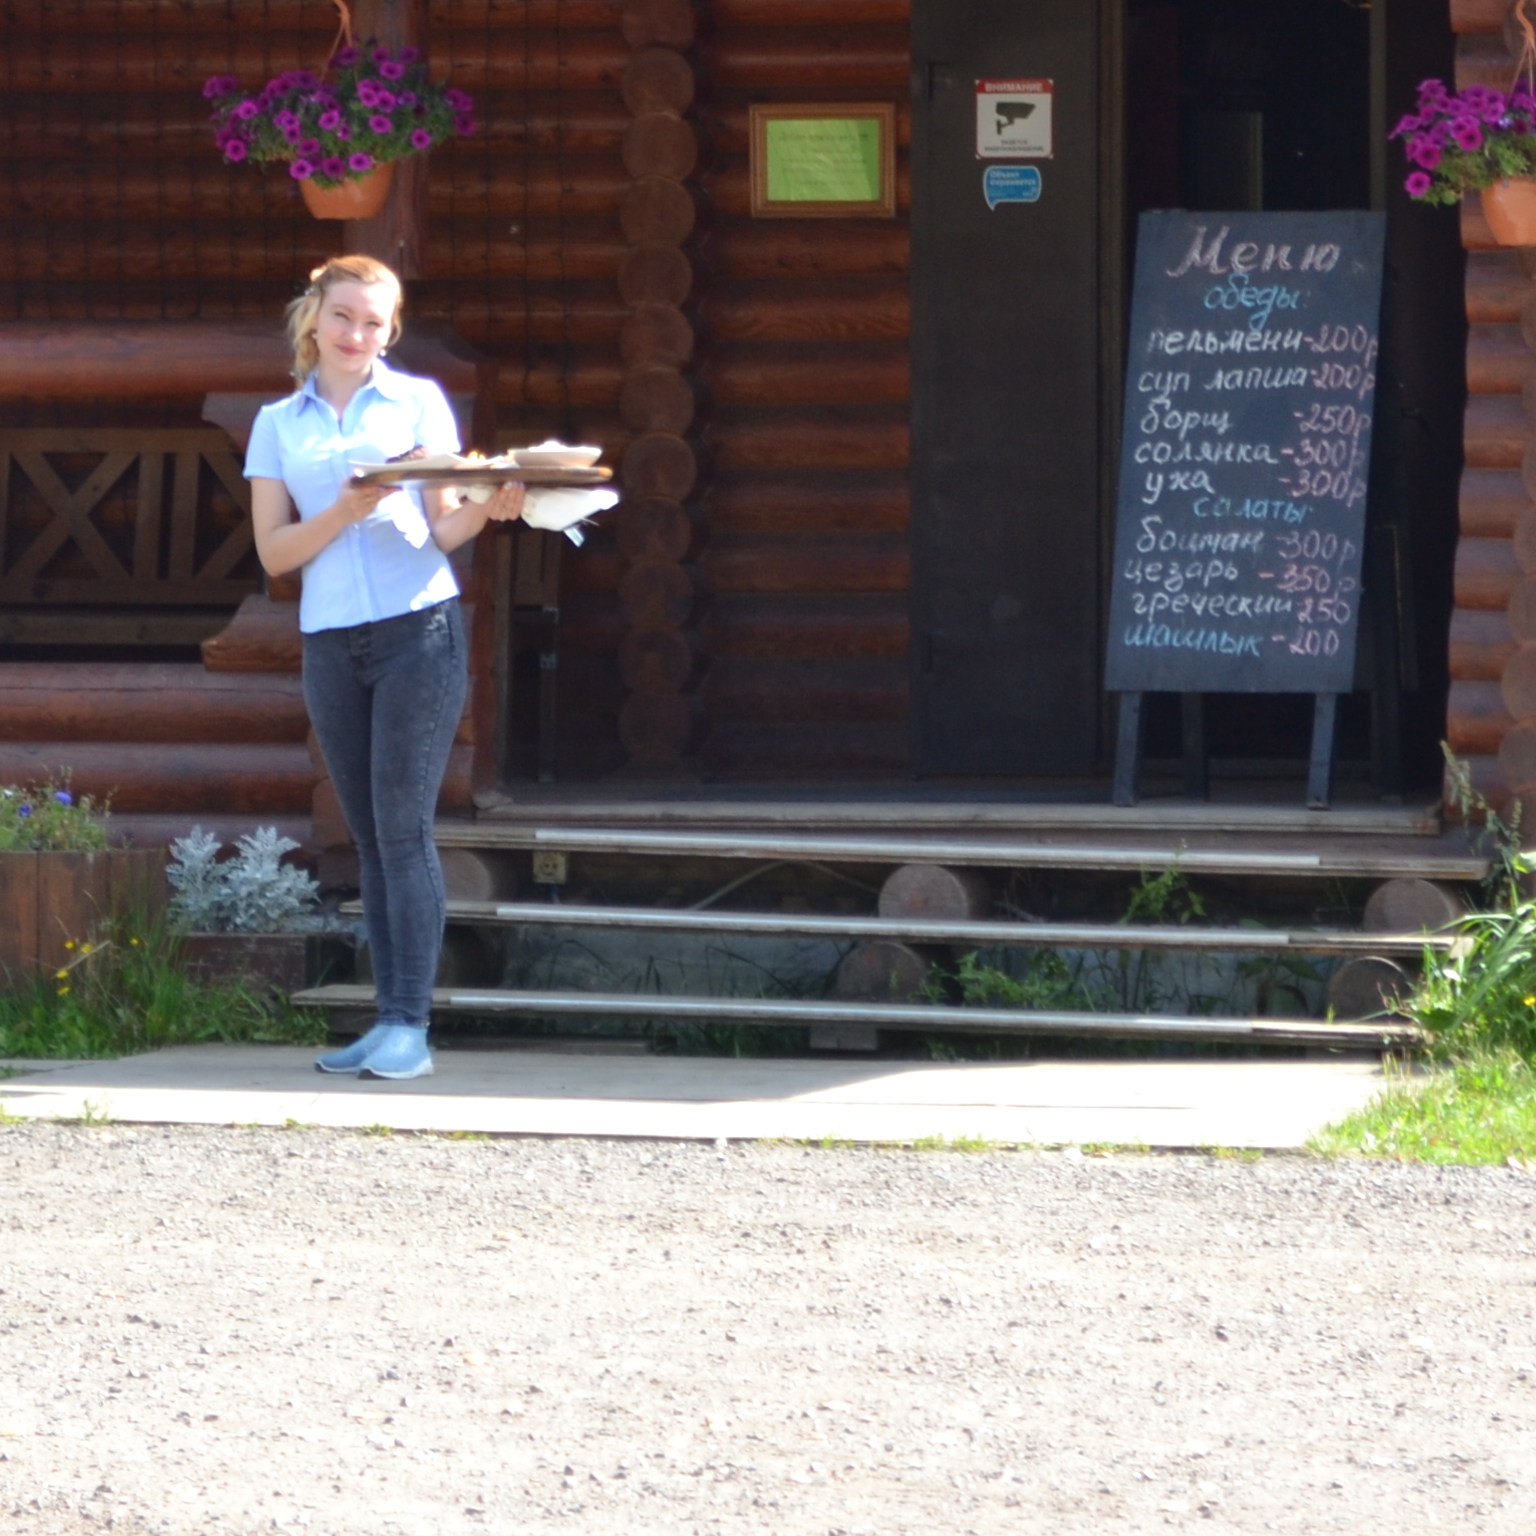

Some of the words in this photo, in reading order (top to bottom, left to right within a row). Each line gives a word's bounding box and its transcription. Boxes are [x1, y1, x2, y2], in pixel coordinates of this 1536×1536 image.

[1166, 226, 1340, 277] Меню
[1137, 370, 1191, 399] суп
[1140, 397, 1235, 441] борщ
[1135, 440, 1279, 465] солянка
[1142, 470, 1216, 505] уха
[1136, 515, 1264, 554] боцман
[1124, 558, 1239, 592] цезарь
[1124, 623, 1264, 656] шашлык
